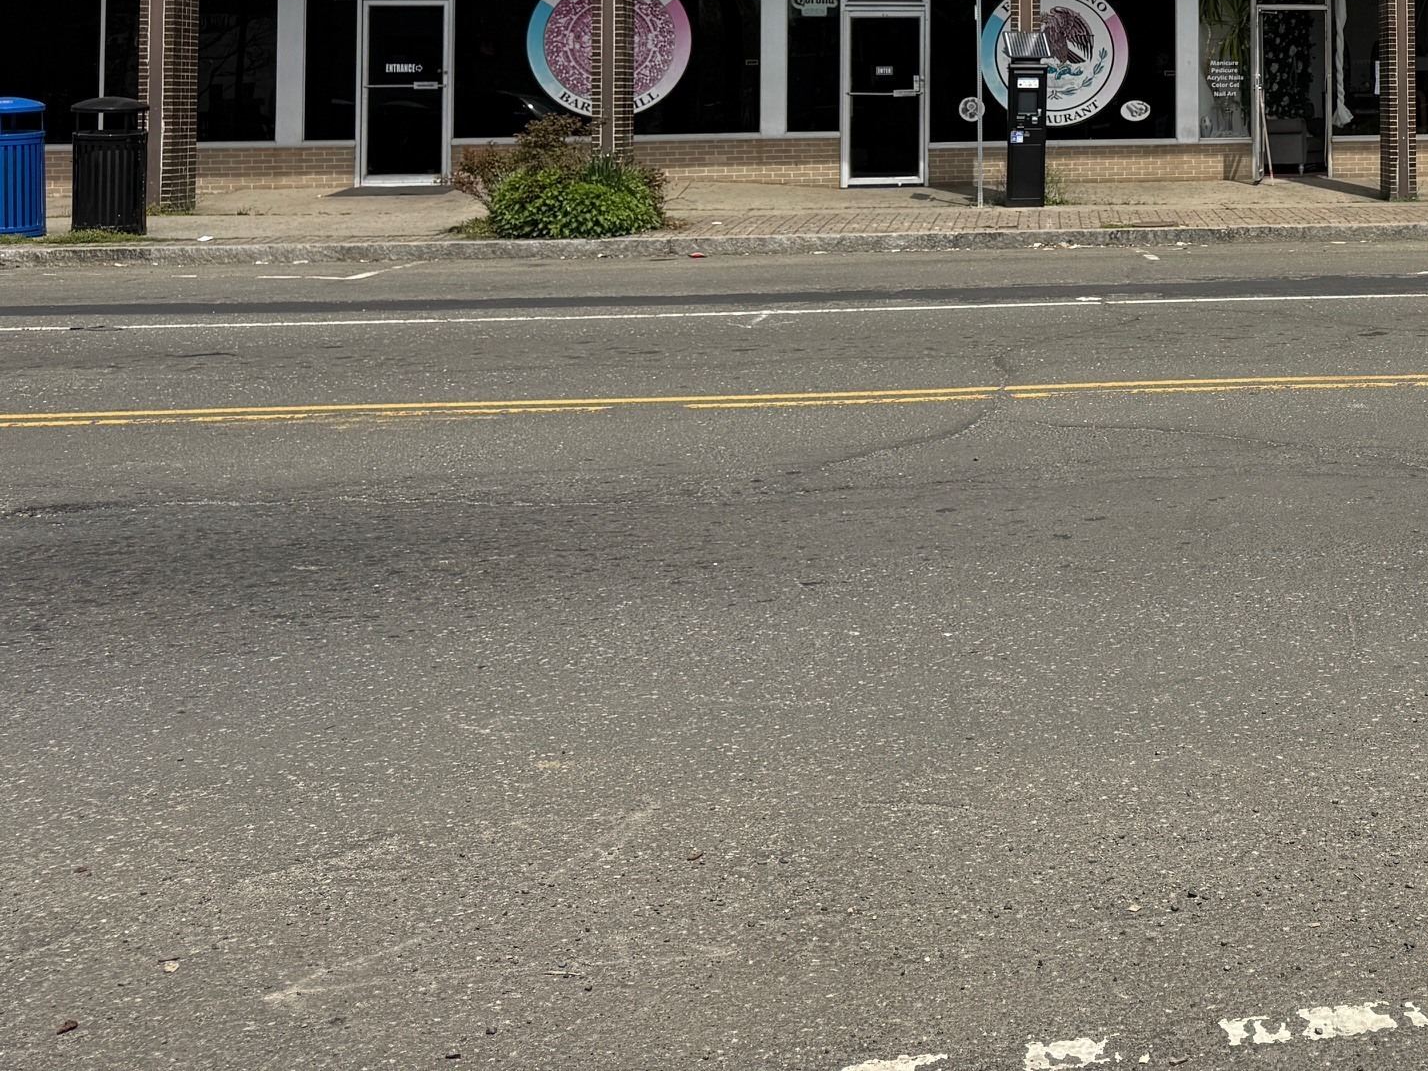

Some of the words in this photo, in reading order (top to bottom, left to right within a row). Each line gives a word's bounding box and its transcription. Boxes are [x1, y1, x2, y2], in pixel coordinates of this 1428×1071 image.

[386, 64, 415, 73] ENTRANCE
[559, 91, 591, 112] BAR
[1046, 99, 1100, 124] AURANT
